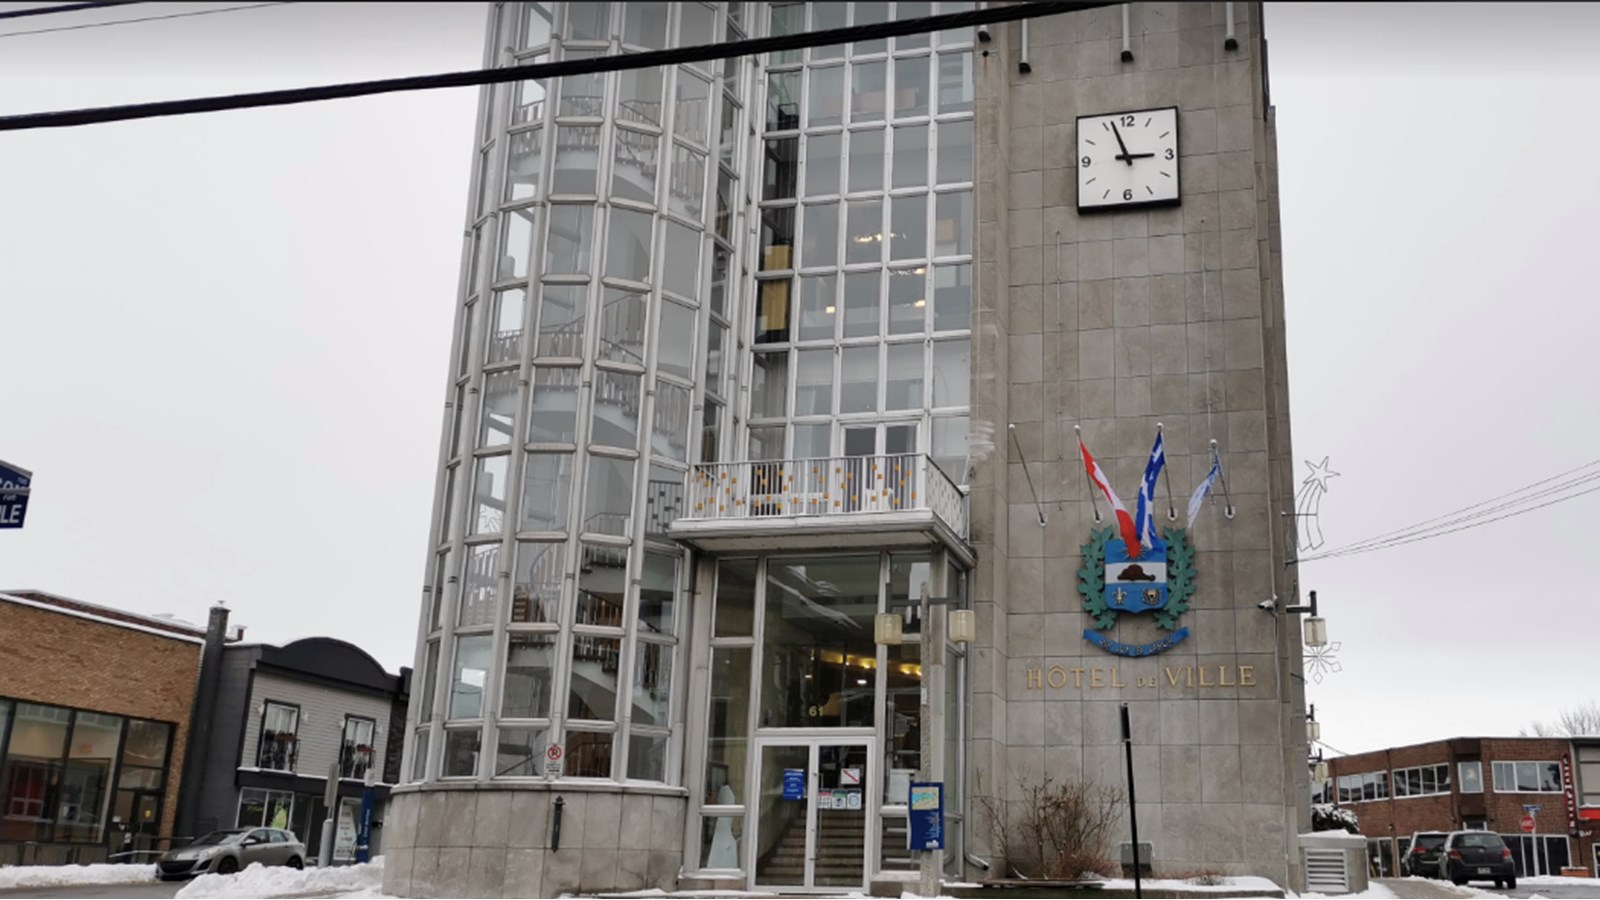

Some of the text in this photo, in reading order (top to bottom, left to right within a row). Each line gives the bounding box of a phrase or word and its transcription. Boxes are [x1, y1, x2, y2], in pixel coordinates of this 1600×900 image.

[1120, 115, 1135, 127] 12
[1164, 148, 1174, 160] 3
[1081, 156, 1091, 168] 9
[1122, 189, 1133, 200] 6
[1026, 662, 1127, 690] HÔTEL
[1164, 665, 1257, 688] VILLE
[808, 705, 824, 717] 61
